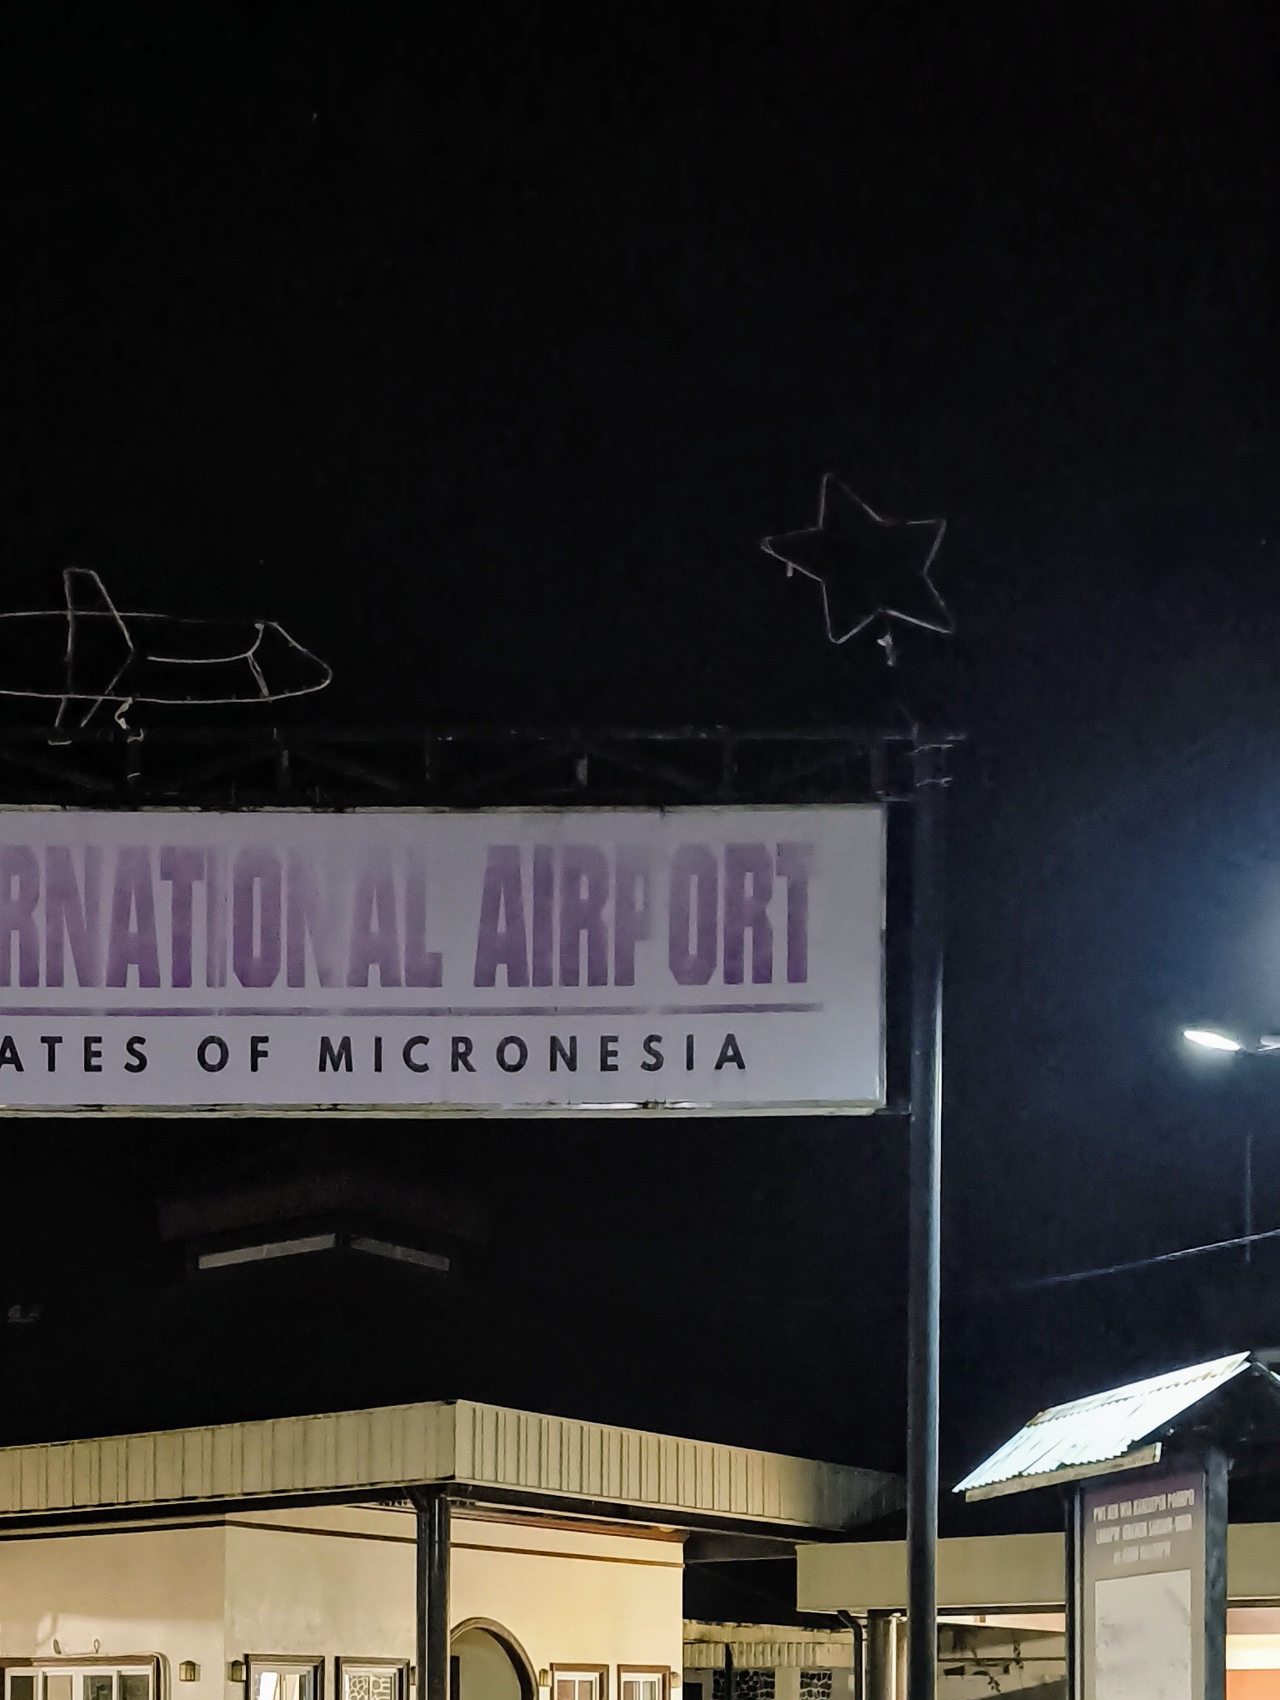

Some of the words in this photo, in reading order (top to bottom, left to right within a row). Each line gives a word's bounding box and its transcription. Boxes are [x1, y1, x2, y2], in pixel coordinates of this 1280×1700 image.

[473, 842, 817, 987] AIRPORT
[196, 1035, 270, 1073] OF
[318, 1033, 746, 1073] MICRONESIA
